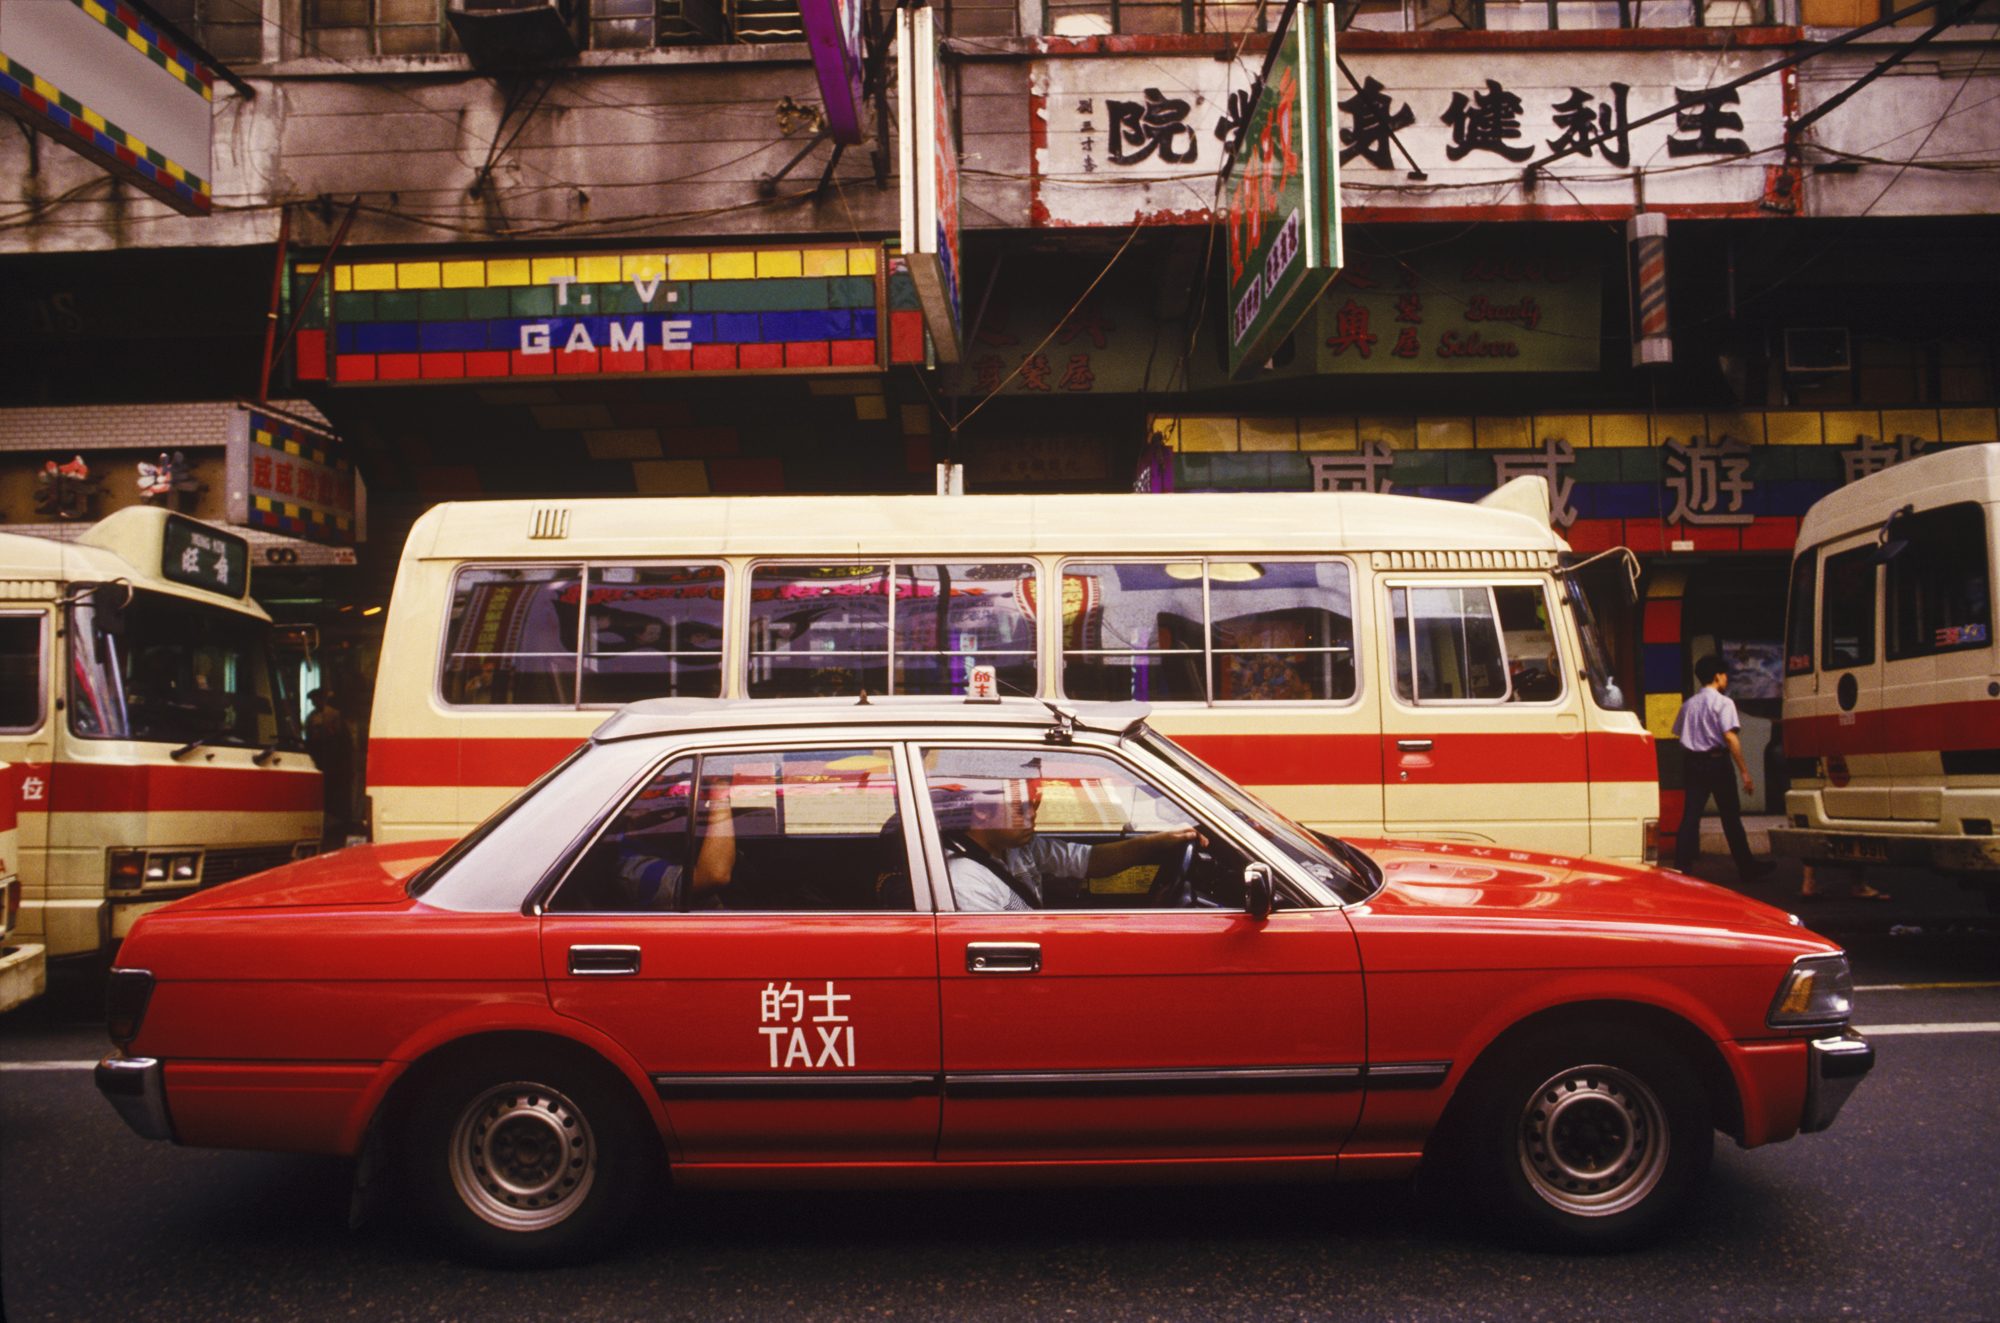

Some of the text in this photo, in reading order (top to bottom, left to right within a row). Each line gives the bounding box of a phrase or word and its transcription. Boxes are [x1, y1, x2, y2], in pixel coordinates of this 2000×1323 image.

[549, 273, 678, 306] T. V.
[1466, 295, 1541, 328] Beauty
[520, 320, 693, 355] GAME
[974, 671, 990, 694] 的士
[21, 776, 46, 801] 位
[761, 981, 852, 1023] 的士
[758, 1026, 856, 1068] TAXI
